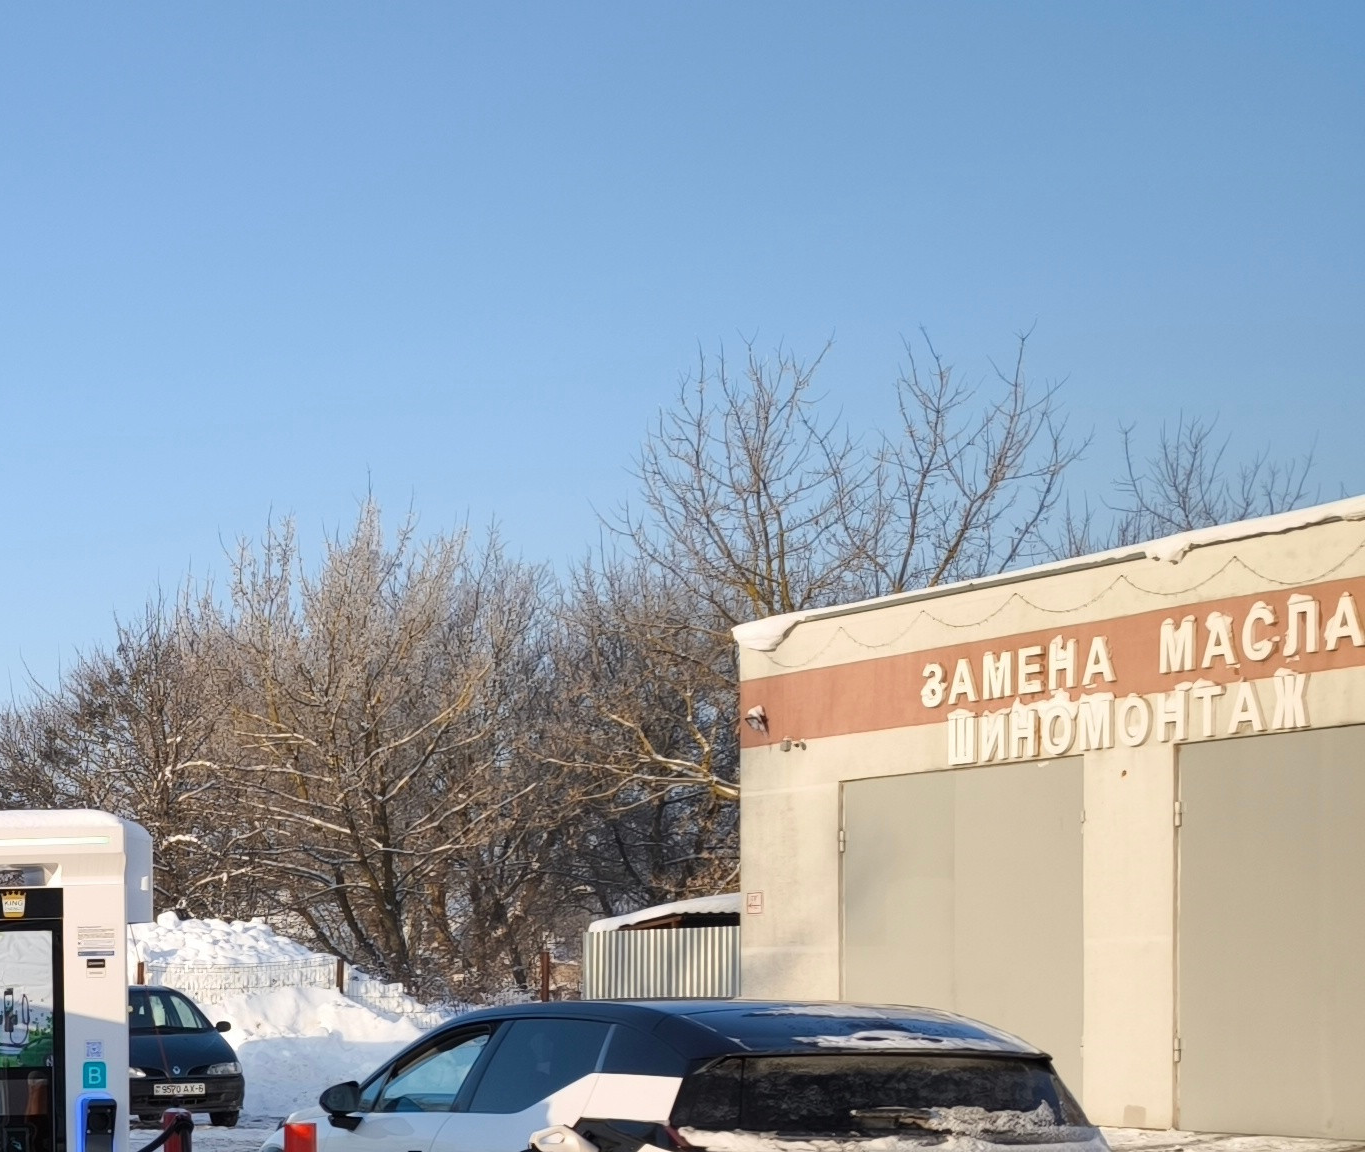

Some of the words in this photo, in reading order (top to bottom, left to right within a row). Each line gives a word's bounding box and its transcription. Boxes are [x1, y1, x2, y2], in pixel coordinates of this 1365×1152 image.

[921, 635, 1117, 708] ЗАМЕНА
[1159, 592, 1365, 675] МАСЛА
[947, 670, 1311, 765] ШИНОМОНТАЖ
[88, 1067, 101, 1085] B
